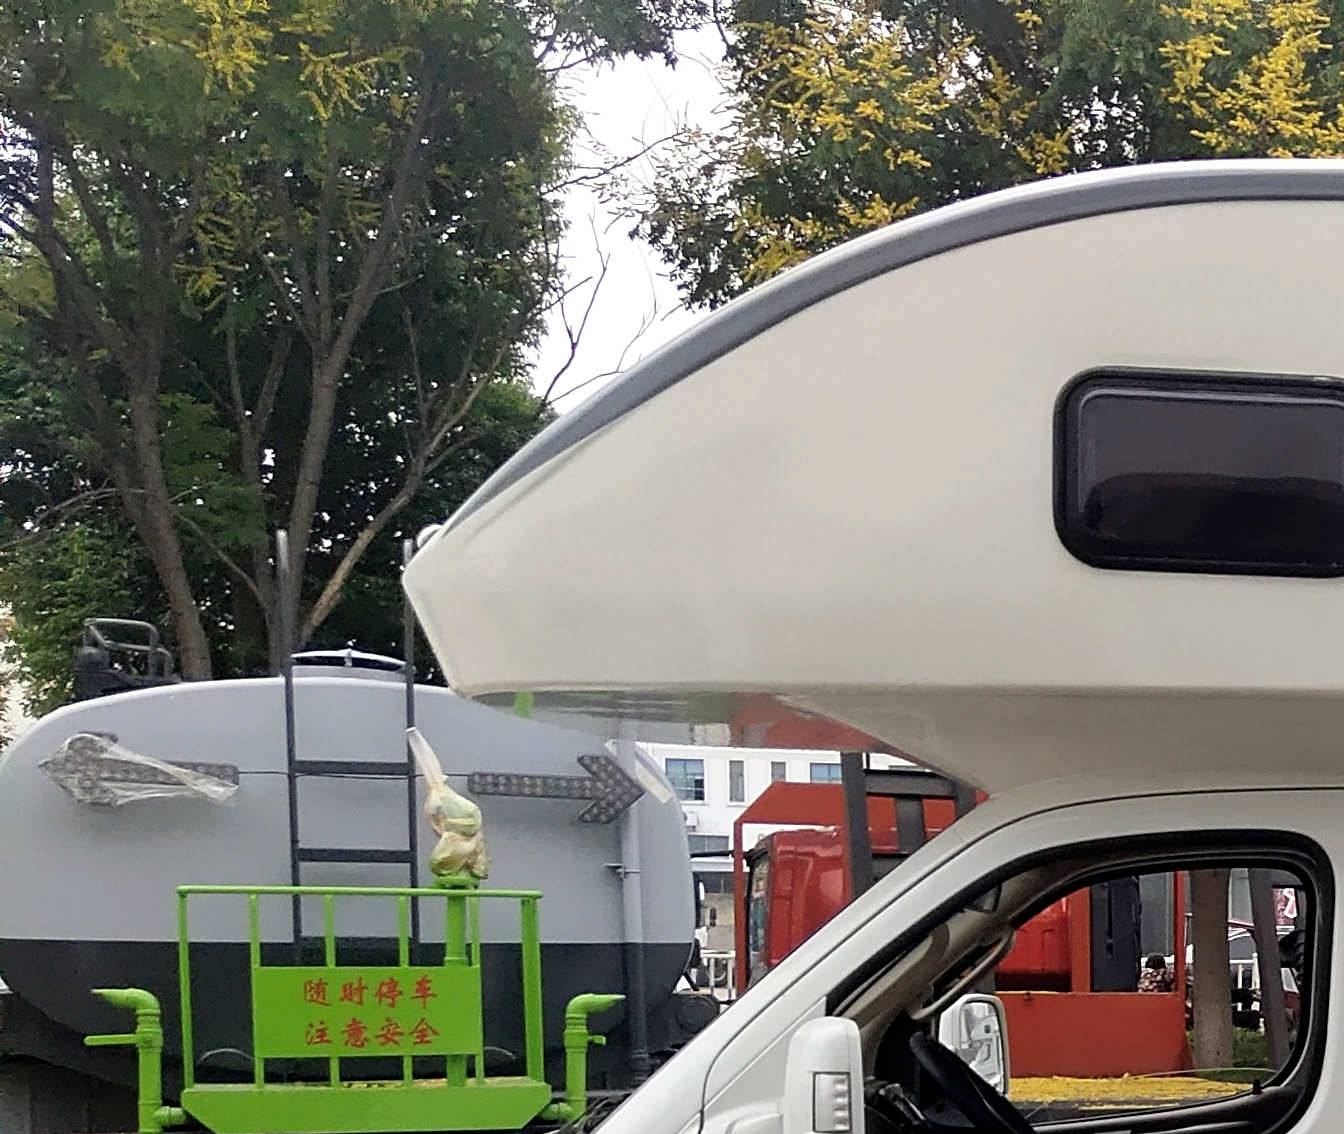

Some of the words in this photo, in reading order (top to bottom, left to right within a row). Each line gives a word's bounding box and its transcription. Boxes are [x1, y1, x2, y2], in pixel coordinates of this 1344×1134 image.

[303, 974, 438, 1009] 随时停车
[305, 1017, 441, 1048] 注意安全
